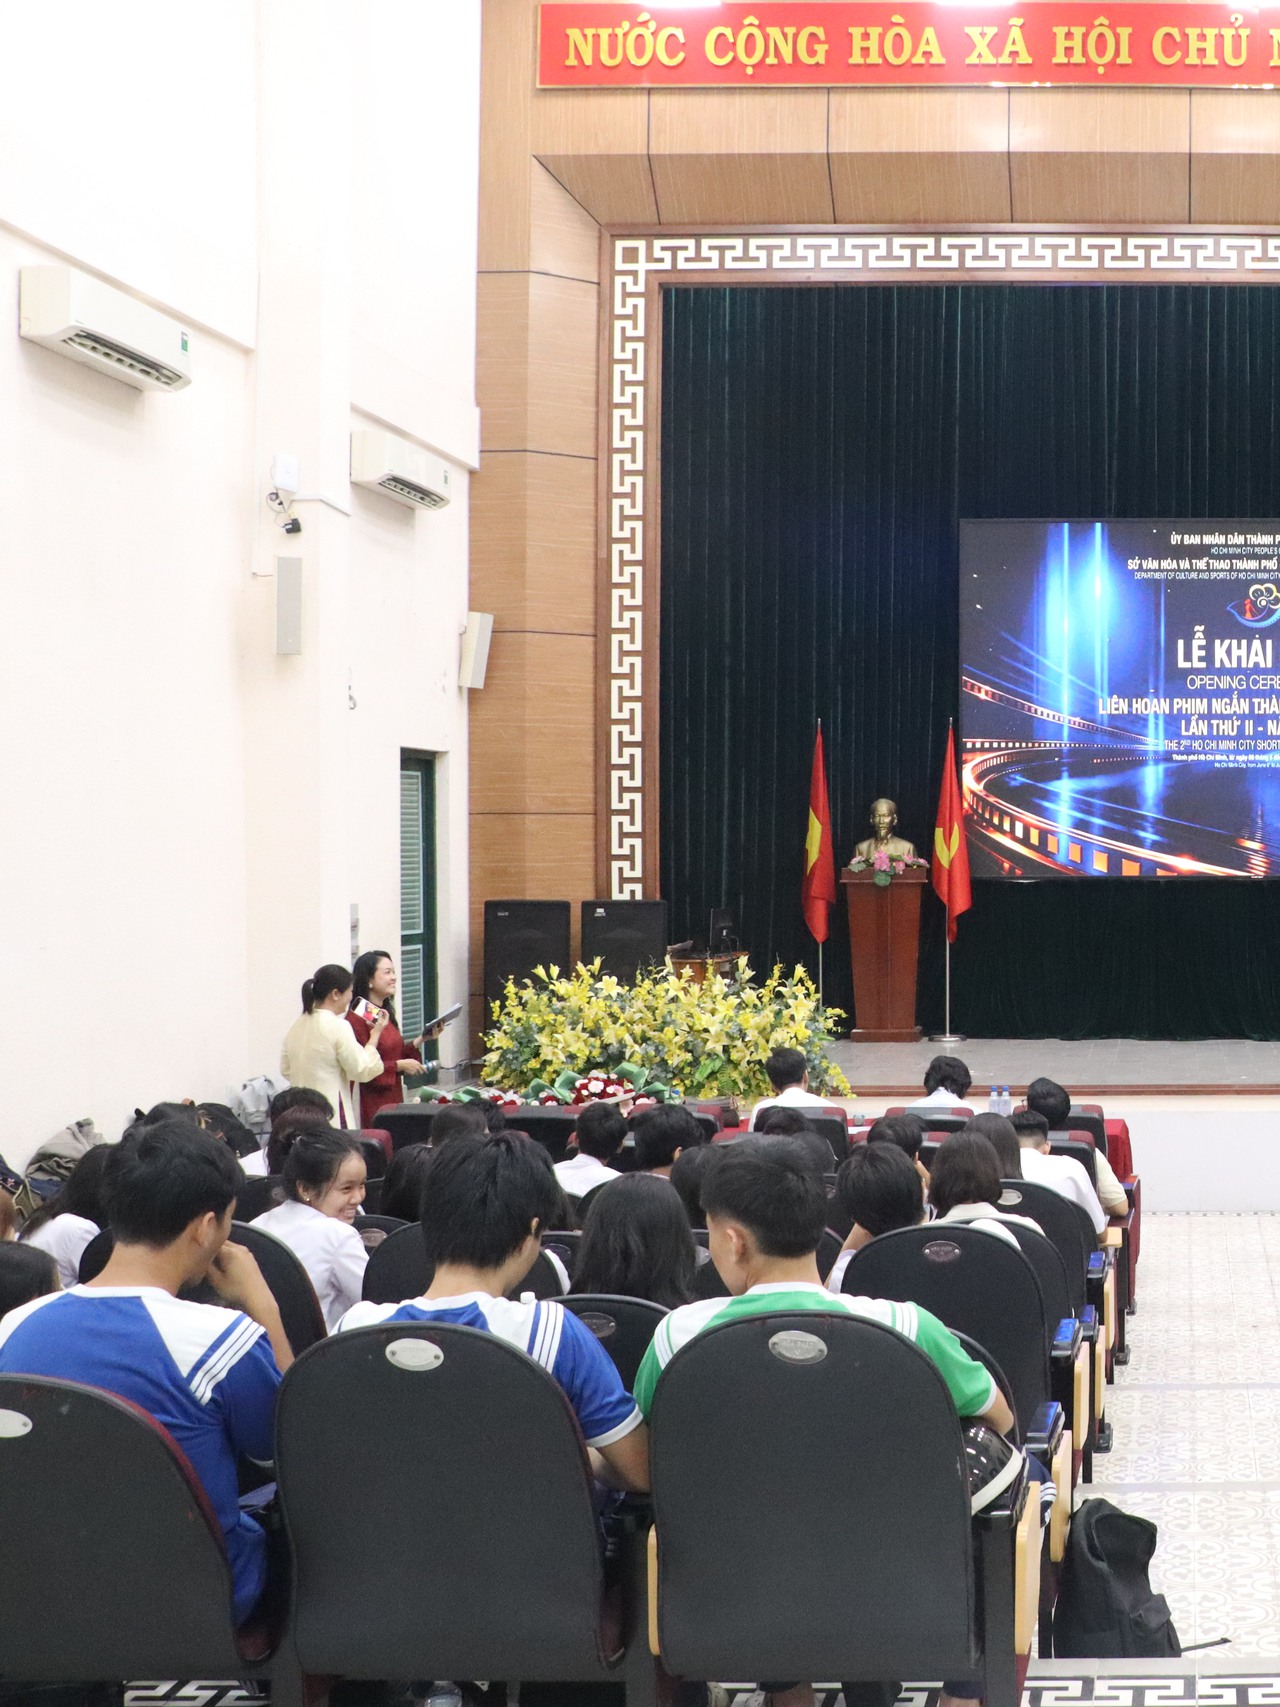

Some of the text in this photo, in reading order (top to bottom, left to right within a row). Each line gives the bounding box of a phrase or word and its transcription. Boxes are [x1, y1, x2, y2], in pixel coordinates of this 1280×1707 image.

[565, 14, 686, 67] NƯỚC
[704, 17, 828, 75] CỘNG
[849, 14, 946, 66] HÒA
[964, 18, 1032, 64] XÃ
[1052, 16, 1133, 74] HỘI
[1151, 13, 1250, 67] CHỦ
[1171, 531, 1182, 545] ỦY
[1183, 534, 1201, 545] BAN
[1202, 532, 1225, 545] NHÂN
[1227, 532, 1244, 545] DÂN
[1246, 532, 1273, 545] THÀNH
[1210, 546, 1218, 555] HO
[1219, 546, 1228, 555] CHI
[1228, 546, 1242, 555] MINH
[1242, 546, 1254, 555] CITY
[1127, 556, 1141, 570] SỞ
[1142, 557, 1159, 570] VĂN
[1160, 556, 1178, 570] HÓA
[1179, 557, 1190, 570] VÀ
[1192, 556, 1209, 570] THỂ
[1209, 559, 1230, 570] THAO
[1232, 557, 1259, 570] THÀNH
[1261, 556, 1278, 570] PHỐ
[1168, 572, 1175, 580] OF
[1176, 572, 1198, 580] CULTURE
[1199, 572, 1209, 580] AND
[1210, 572, 1230, 580] SPORTS
[1231, 572, 1238, 580] OF
[1238, 572, 1246, 580] HO
[1247, 572, 1256, 580] CHI
[1256, 572, 1269, 580] MINH
[1270, 572, 1280, 580] CITY
[1177, 625, 1207, 669] LỄ
[1186, 675, 1247, 690] OPENING
[1098, 694, 1128, 715] LIÊN
[1132, 698, 1170, 715] HOAN
[1173, 698, 1208, 715] PHIM
[1211, 691, 1250, 715] NGẮN
[1181, 714, 1208, 736] LẦN
[1211, 716, 1241, 736] THỨ
[1245, 719, 1253, 736] II
[1164, 740, 1178, 750] THE
[1192, 740, 1203, 750] HO
[1204, 740, 1217, 750] CHI
[1218, 740, 1236, 750] MINH
[1238, 740, 1255, 750] CITY
